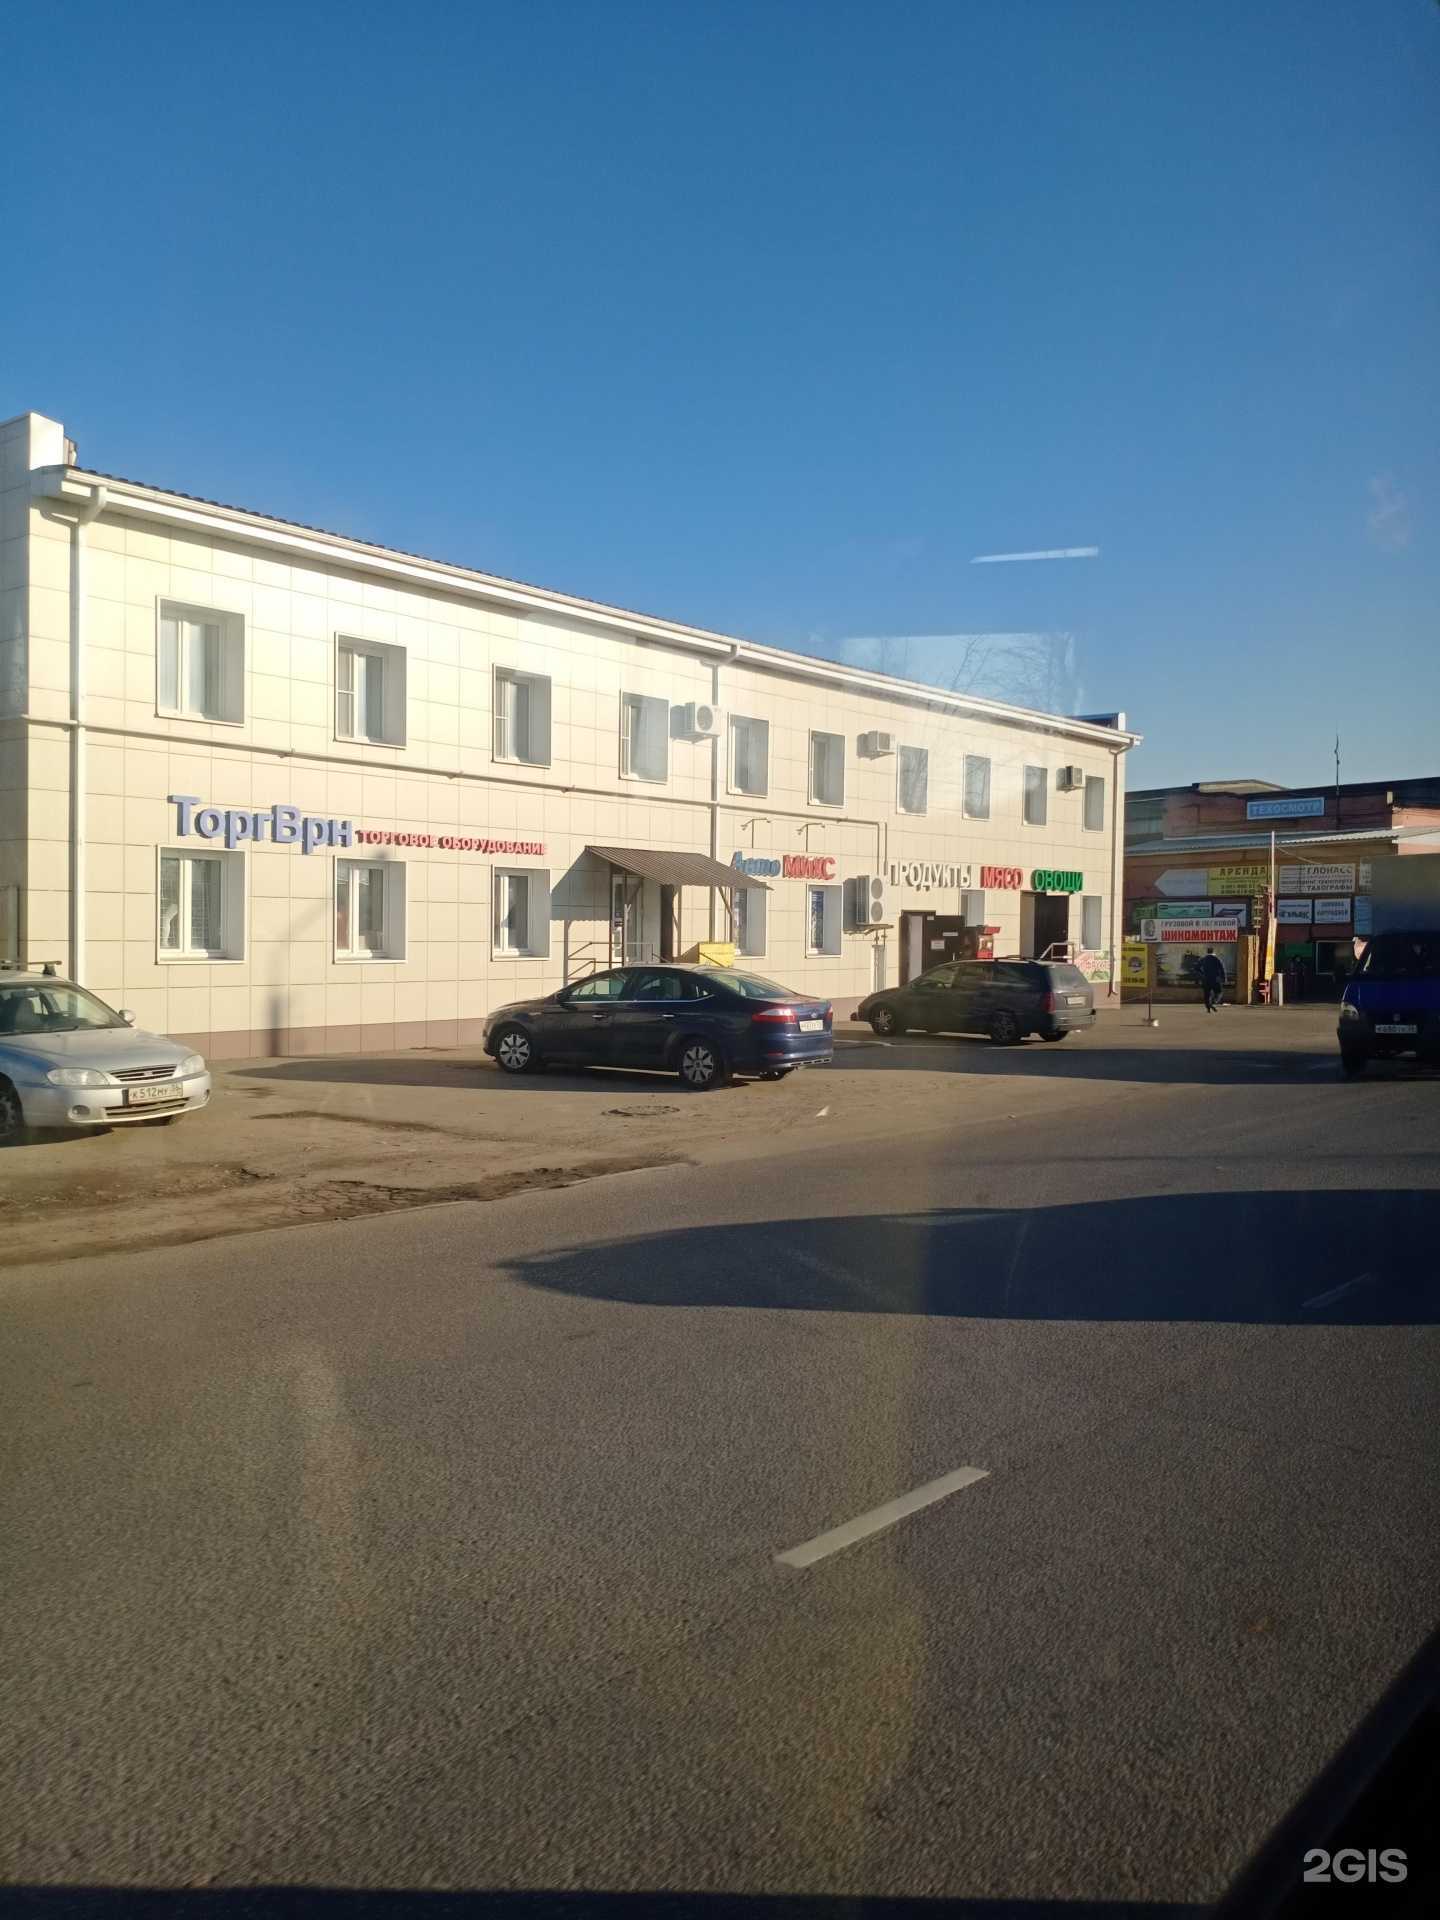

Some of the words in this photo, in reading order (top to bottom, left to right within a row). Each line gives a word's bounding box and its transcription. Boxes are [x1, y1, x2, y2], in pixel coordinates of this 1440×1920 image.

[1252, 801, 1321, 816] ТЕХОСМОТР
[167, 795, 352, 855] ТоргВрн
[355, 830, 439, 849] ТОРГОВОЕ
[1220, 866, 1266, 877] АРЕНДА
[1306, 865, 1353, 875] ГЛОНАСС
[888, 862, 972, 891] ПРОДУКТЫ
[980, 866, 1024, 890] МЯСО
[1031, 869, 1083, 895] ОВОЩИ
[1161, 929, 1237, 941] ШИНОМОНТАЖ
